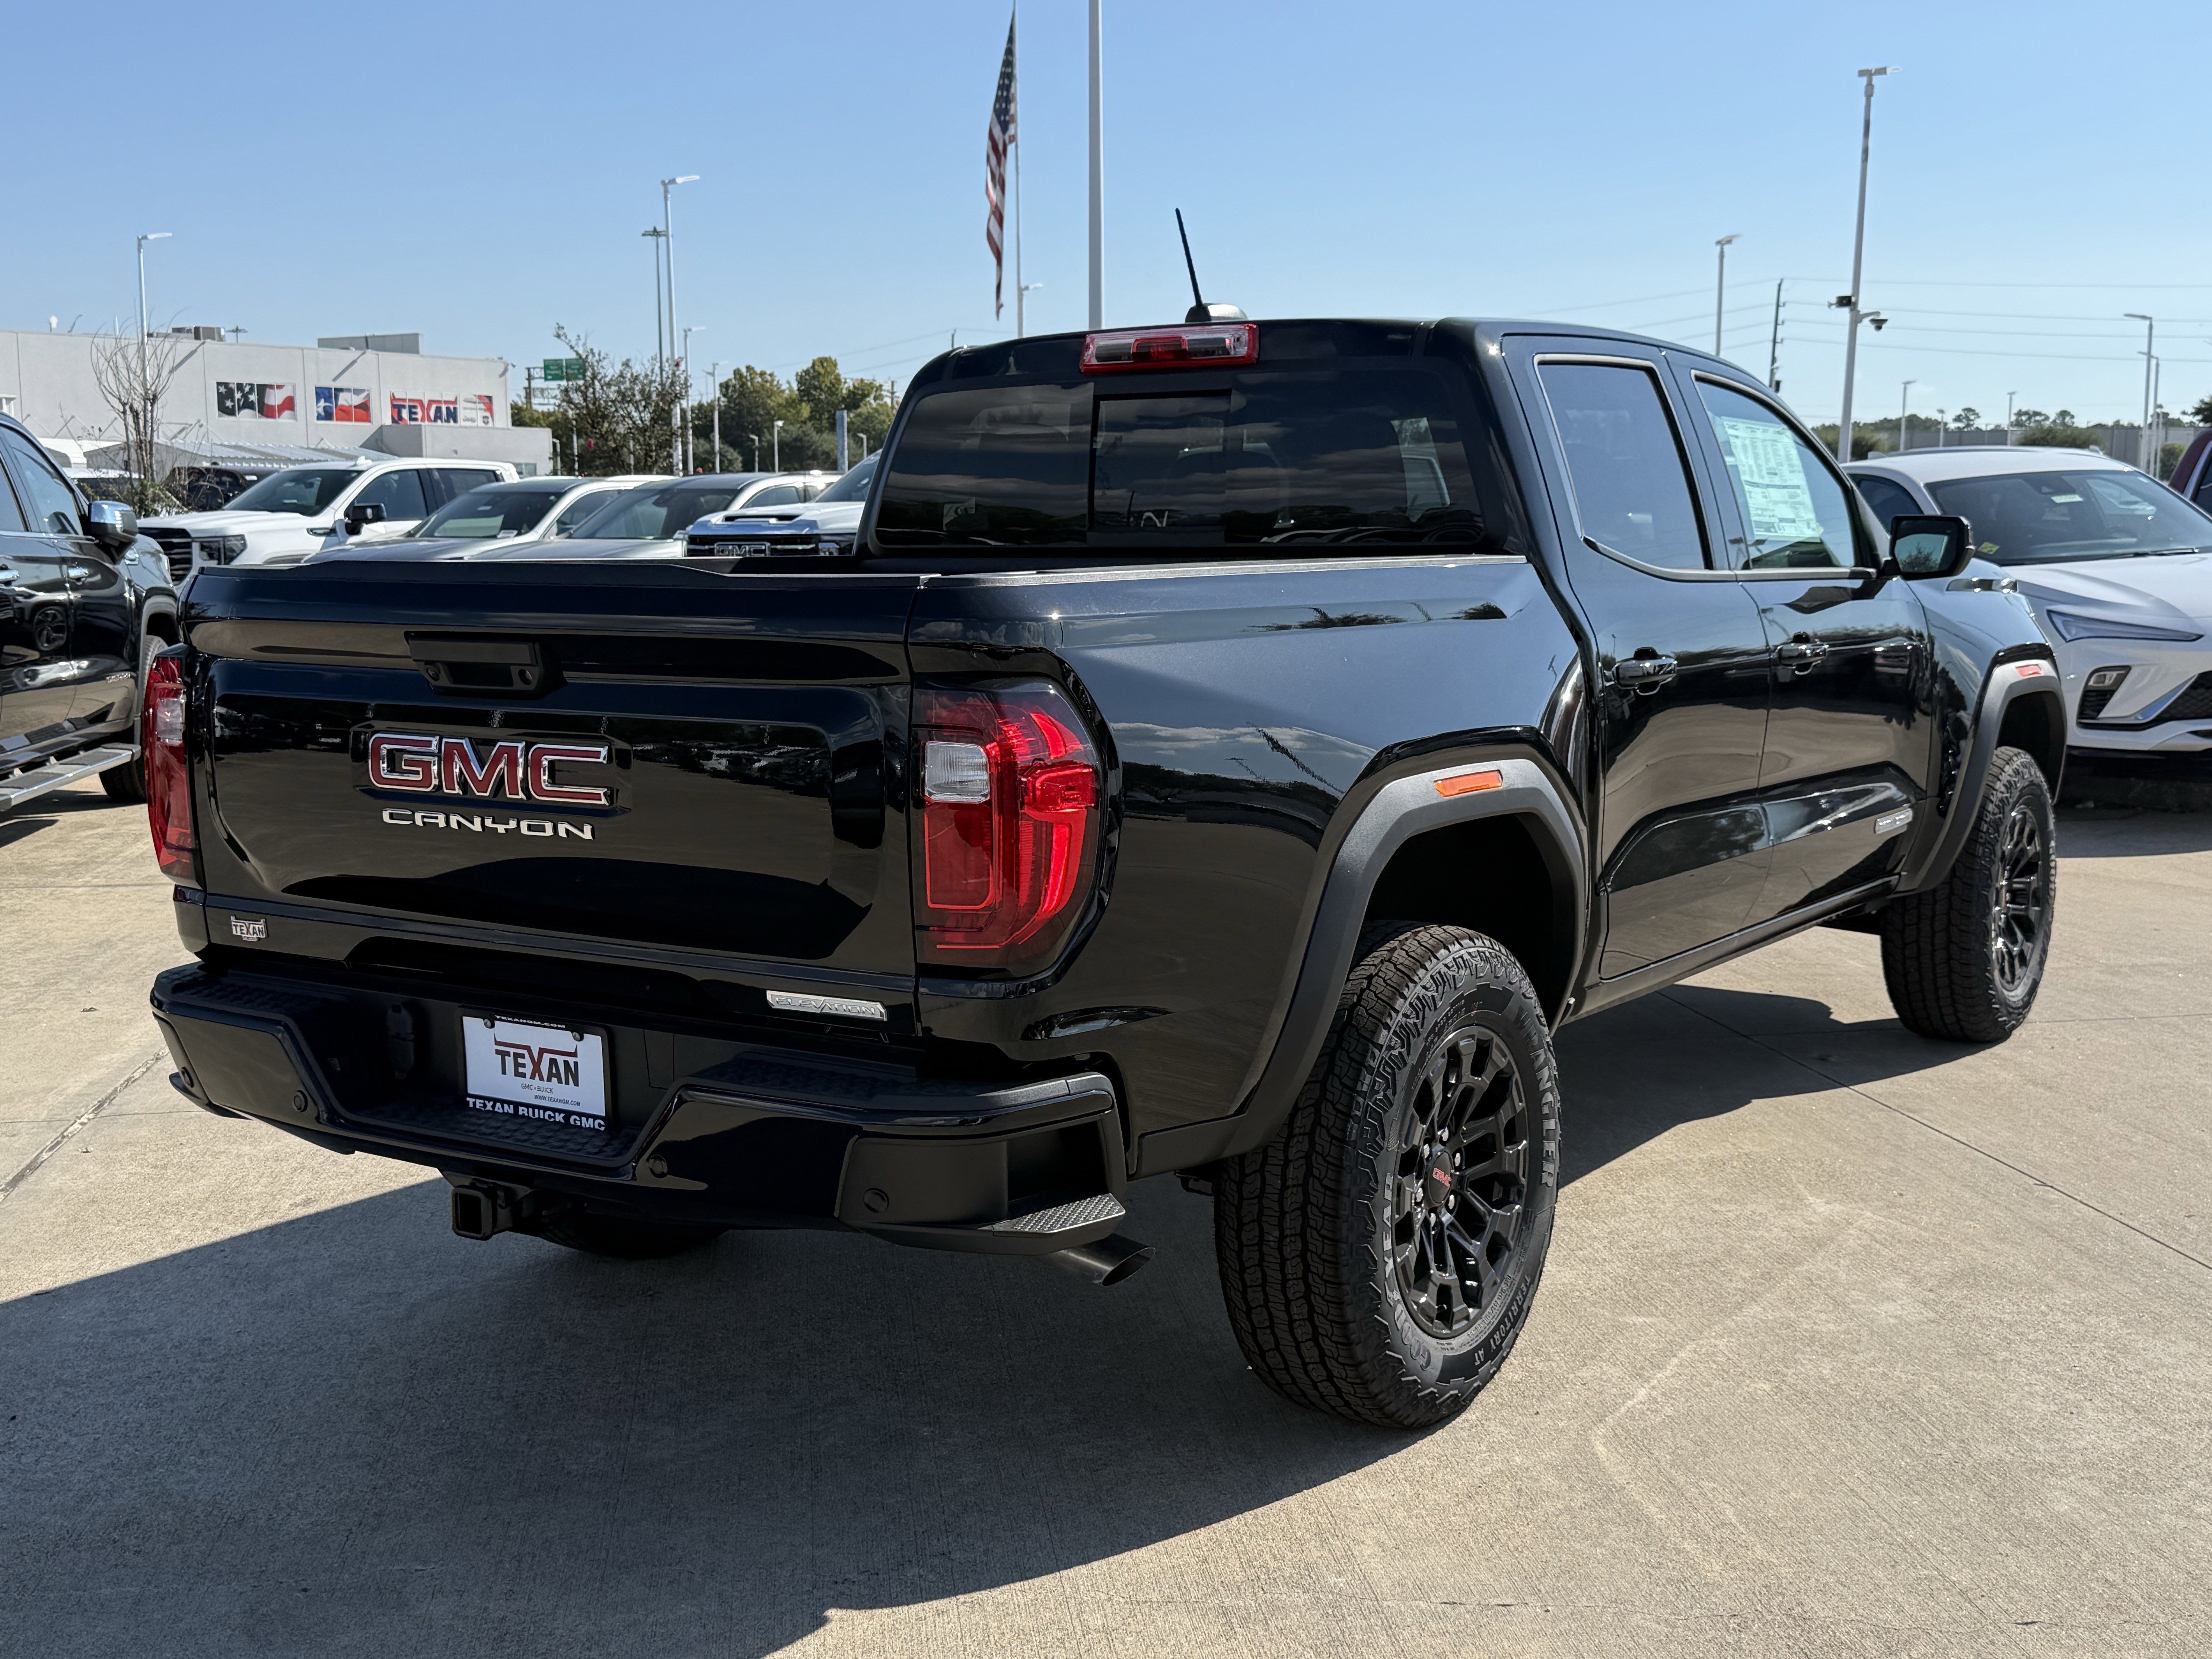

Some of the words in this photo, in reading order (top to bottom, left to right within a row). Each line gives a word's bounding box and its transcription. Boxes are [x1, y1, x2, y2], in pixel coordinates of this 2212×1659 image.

[392, 396, 458, 424] TEXAN
[716, 545, 766, 557] GMC
[368, 733, 609, 806] GMC
[382, 807, 594, 840] CANYON
[232, 921, 265, 937] TEXAN
[776, 997, 875, 1015] ELEVATION
[495, 1015, 566, 1028] TEXANGM.COM
[494, 1033, 579, 1087] TEXAN
[537, 1085, 553, 1094] BUICK
[466, 1097, 514, 1114] TEXAN
[519, 1106, 565, 1123] BUICK
[570, 1115, 605, 1131] GMC
[1432, 1168, 1452, 1188] GMC
[1490, 1275, 1530, 1352] TERRITORY
[1474, 1348, 1484, 1366] AT
